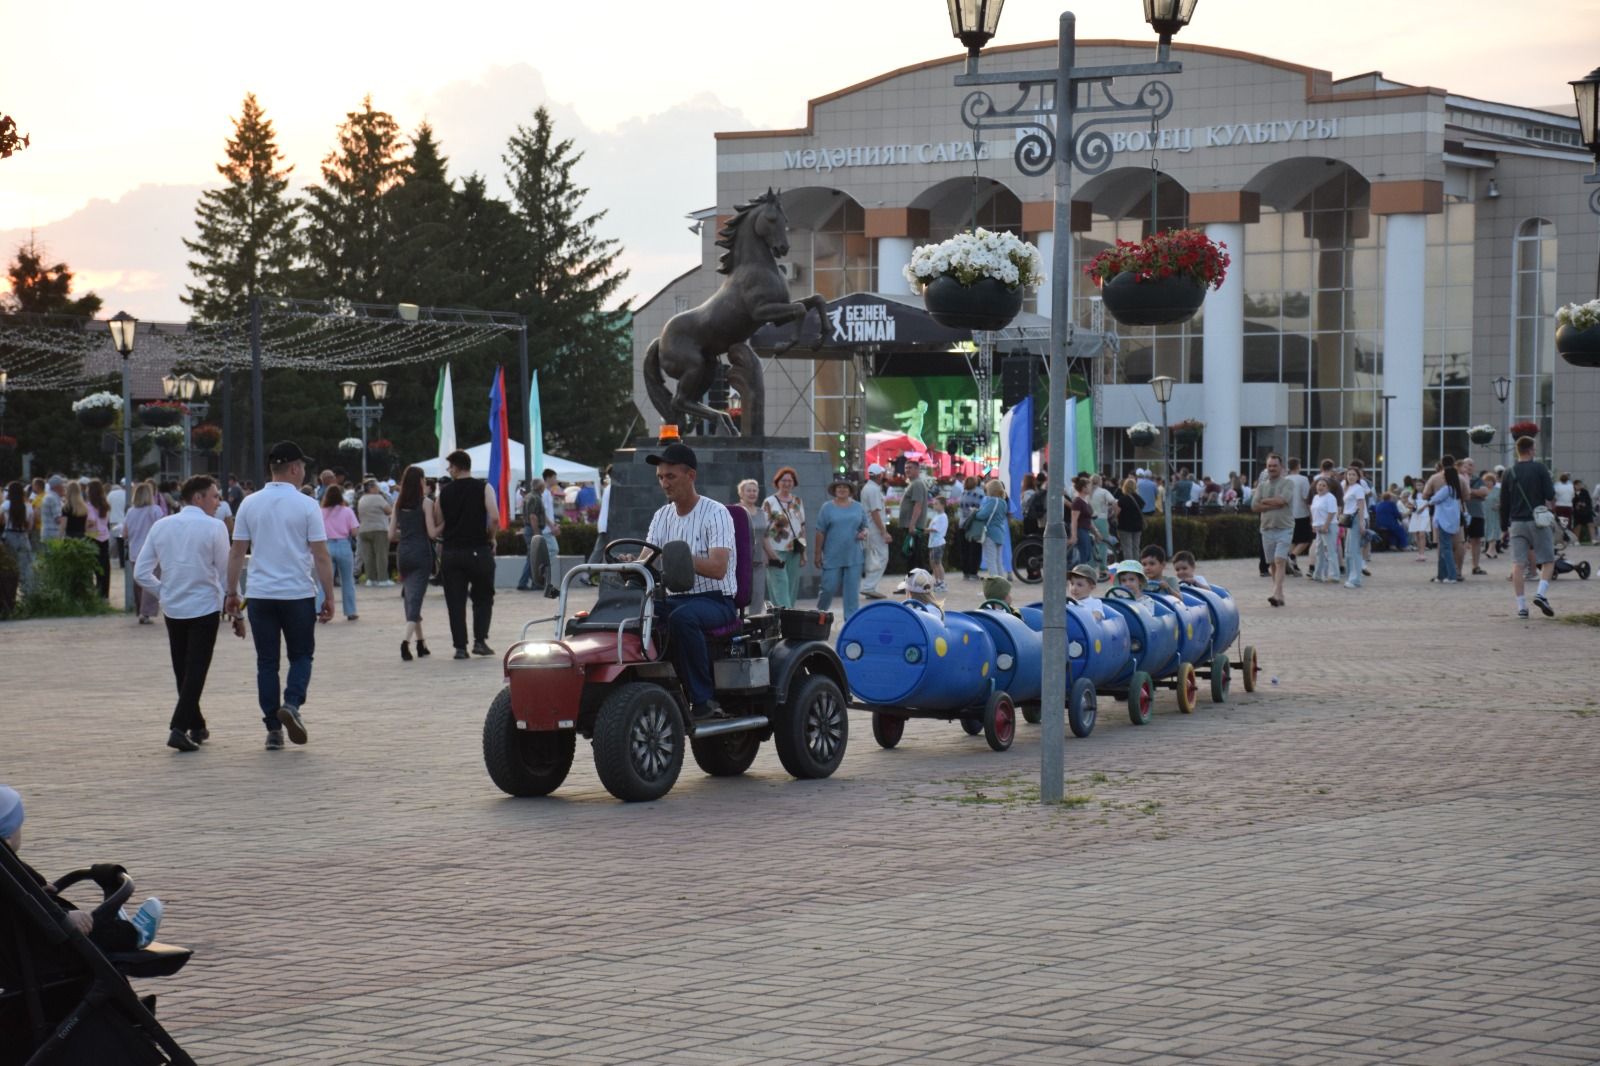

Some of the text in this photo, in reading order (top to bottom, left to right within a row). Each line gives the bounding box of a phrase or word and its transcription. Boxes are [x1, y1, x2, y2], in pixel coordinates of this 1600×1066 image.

[1090, 118, 1341, 154] ВОЕЦ КУЛЬТУРЫ
[783, 145, 911, 173] МӘДӘНИЯТ
[846, 316, 896, 342] ТЯМАЙ
